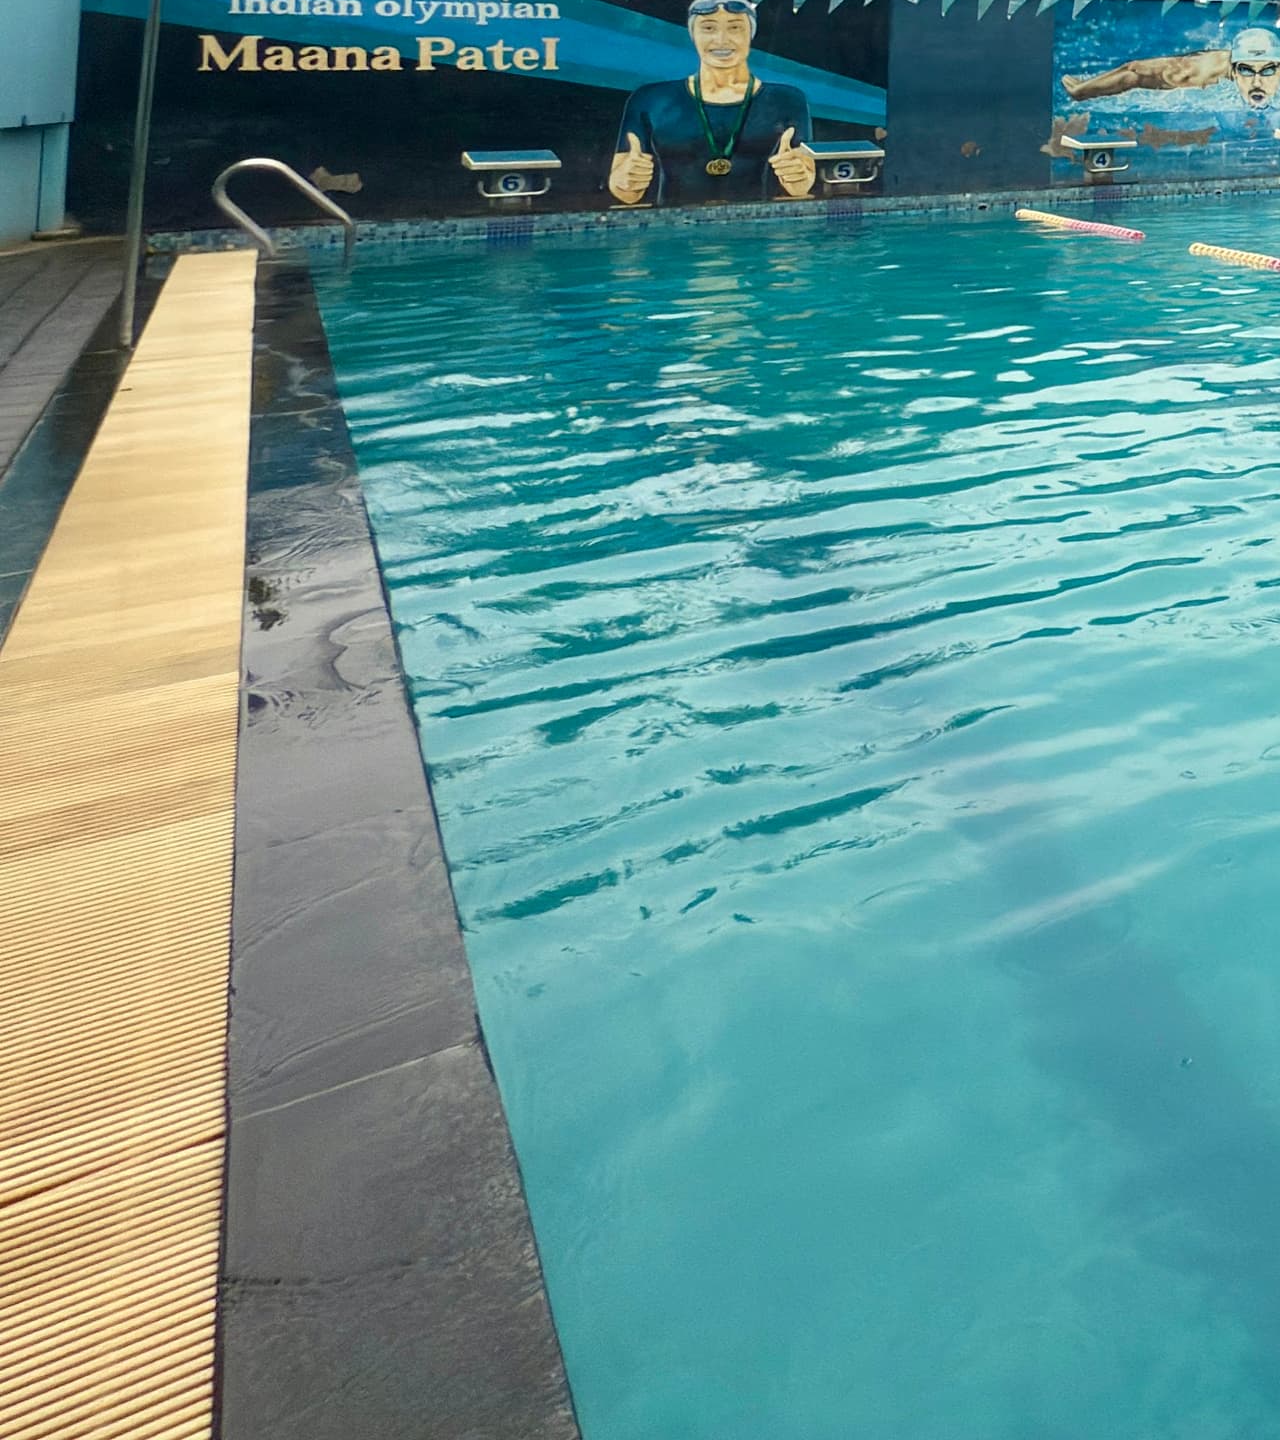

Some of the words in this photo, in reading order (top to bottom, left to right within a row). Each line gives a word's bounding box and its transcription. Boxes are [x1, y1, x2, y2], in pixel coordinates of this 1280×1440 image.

[197, 35, 404, 72] Maana
[415, 37, 561, 72] Patel
[1095, 153, 1107, 166] 4
[838, 164, 851, 178] 5
[502, 175, 520, 191] 6
